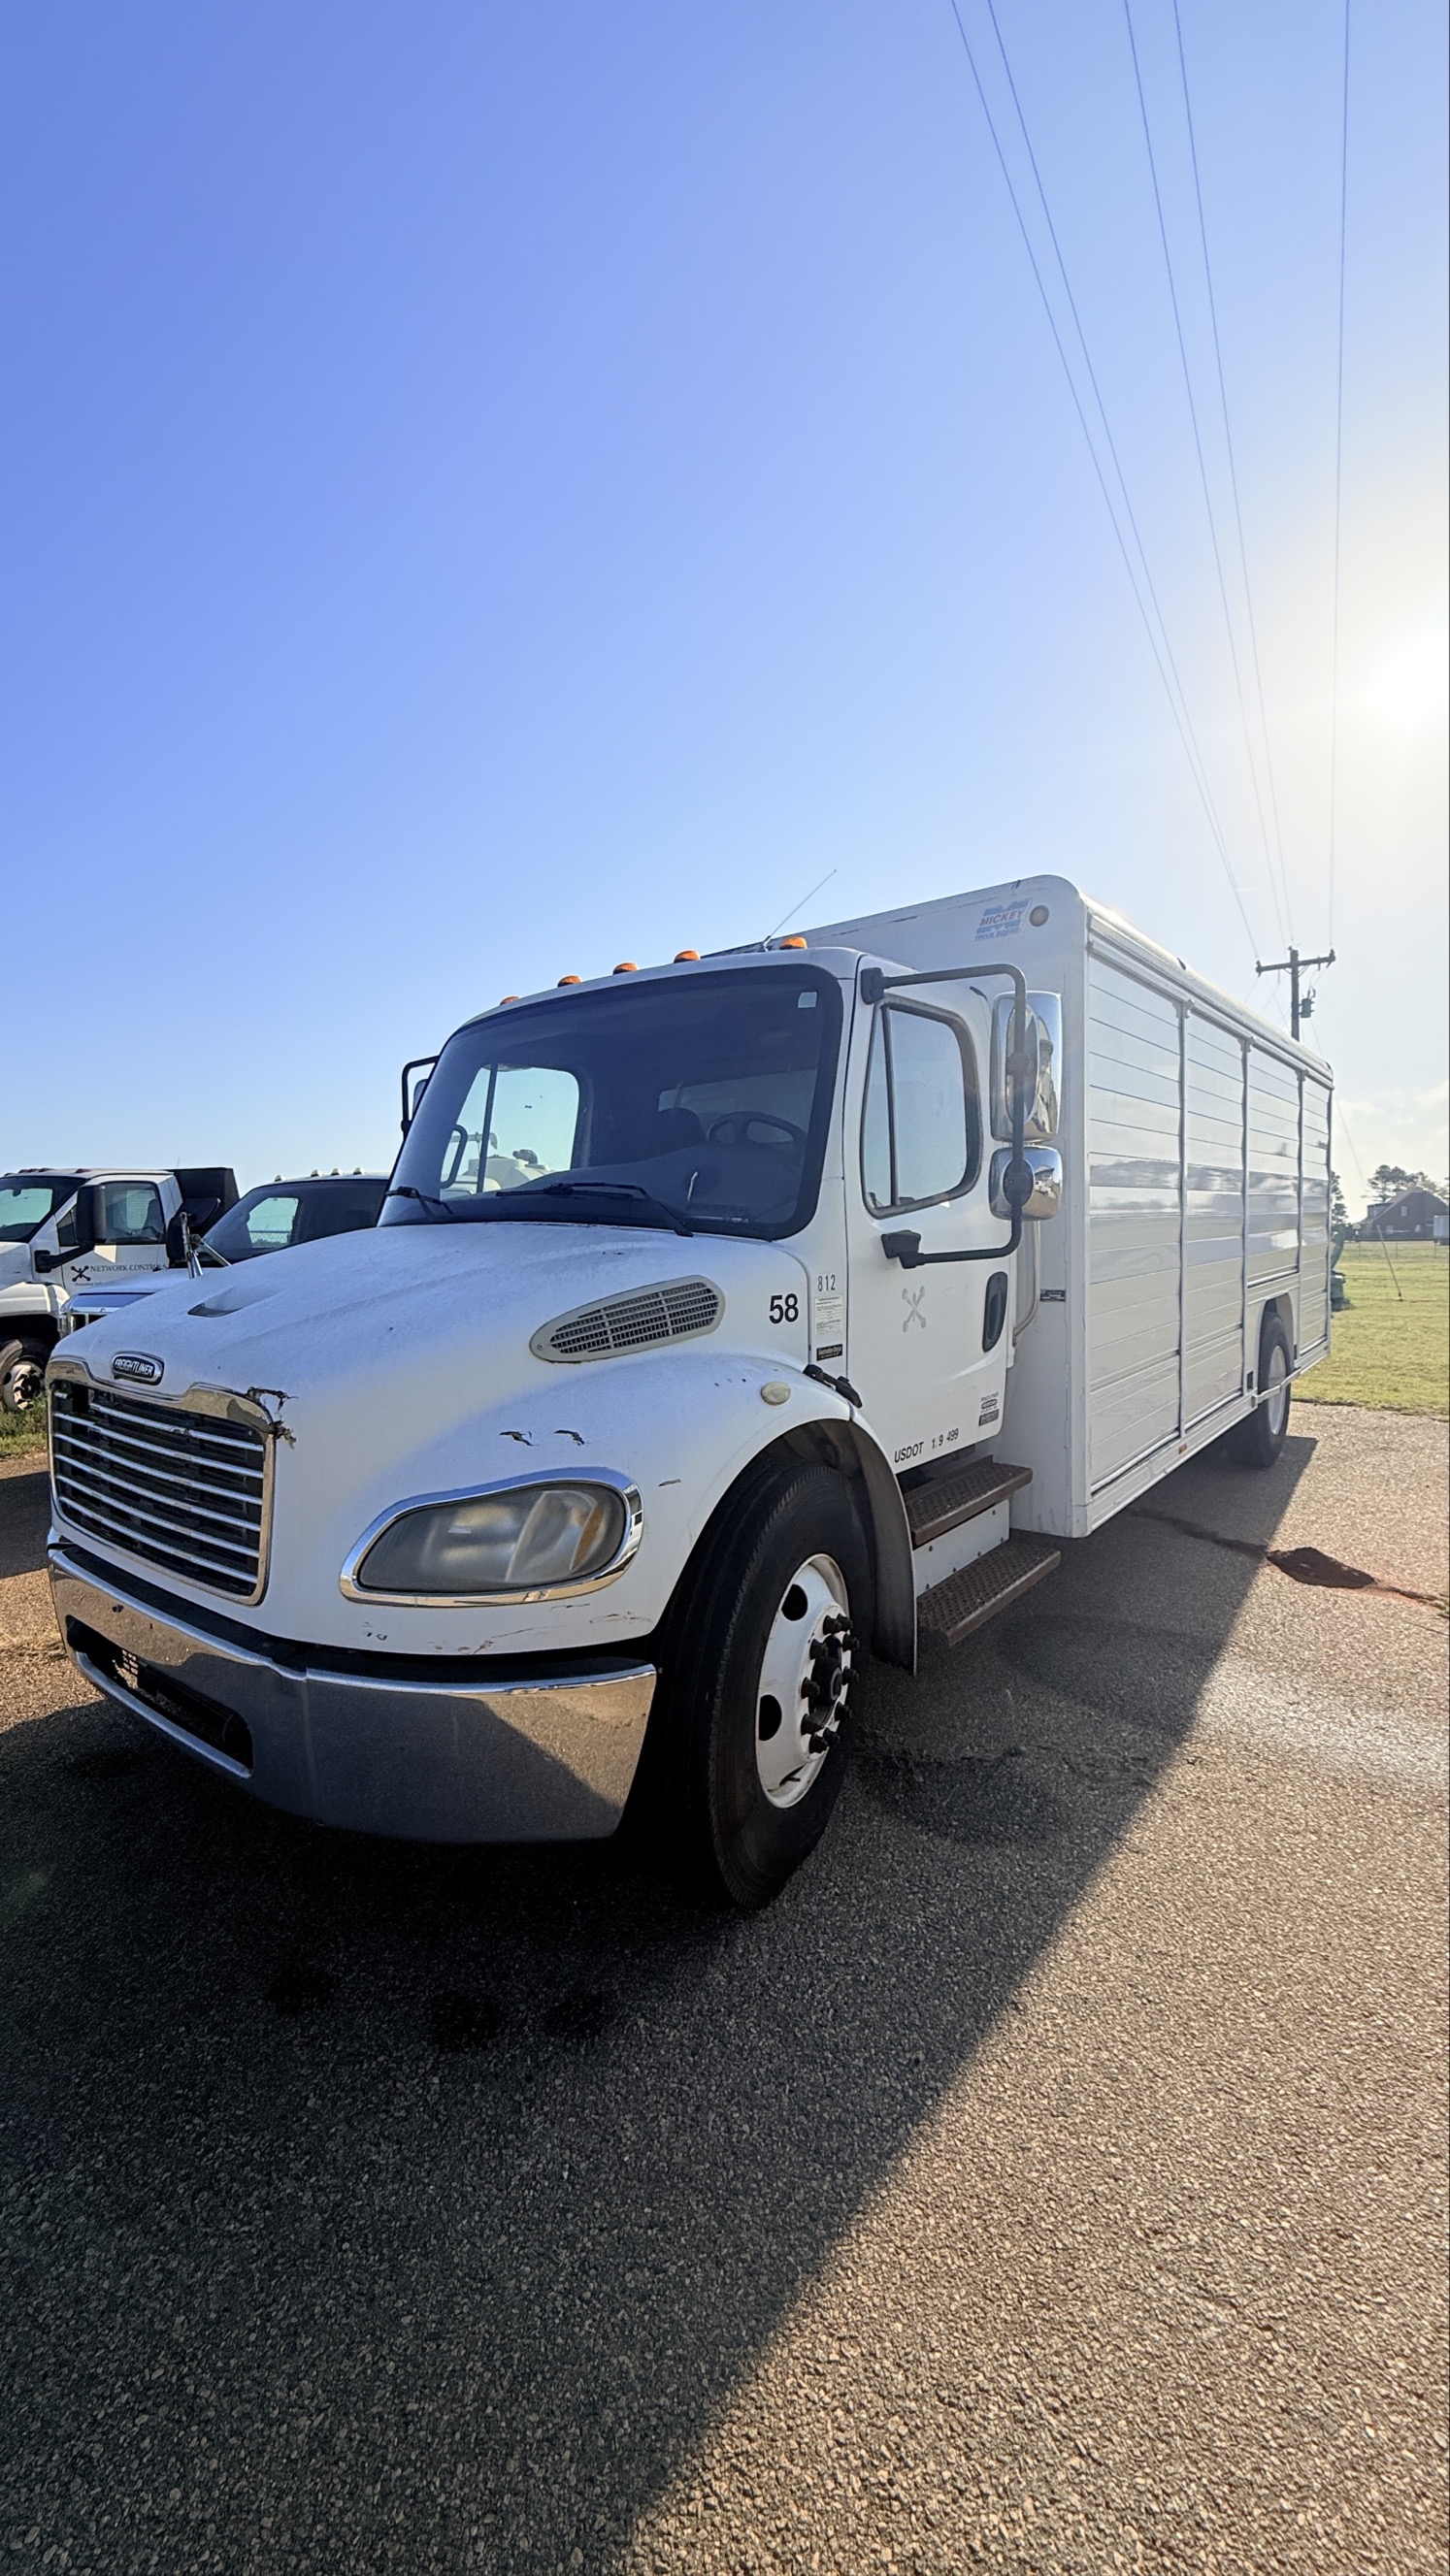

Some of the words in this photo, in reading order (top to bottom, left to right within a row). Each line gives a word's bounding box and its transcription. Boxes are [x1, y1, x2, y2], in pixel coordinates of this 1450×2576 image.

[978, 909, 1025, 927] MICKEY
[90, 1264, 128, 1273] NETWORK
[817, 1274, 837, 1292] 812
[769, 1292, 799, 1324] 58
[115, 1358, 154, 1377] FREIGHTLINER
[894, 1441, 925, 1463] USDOT
